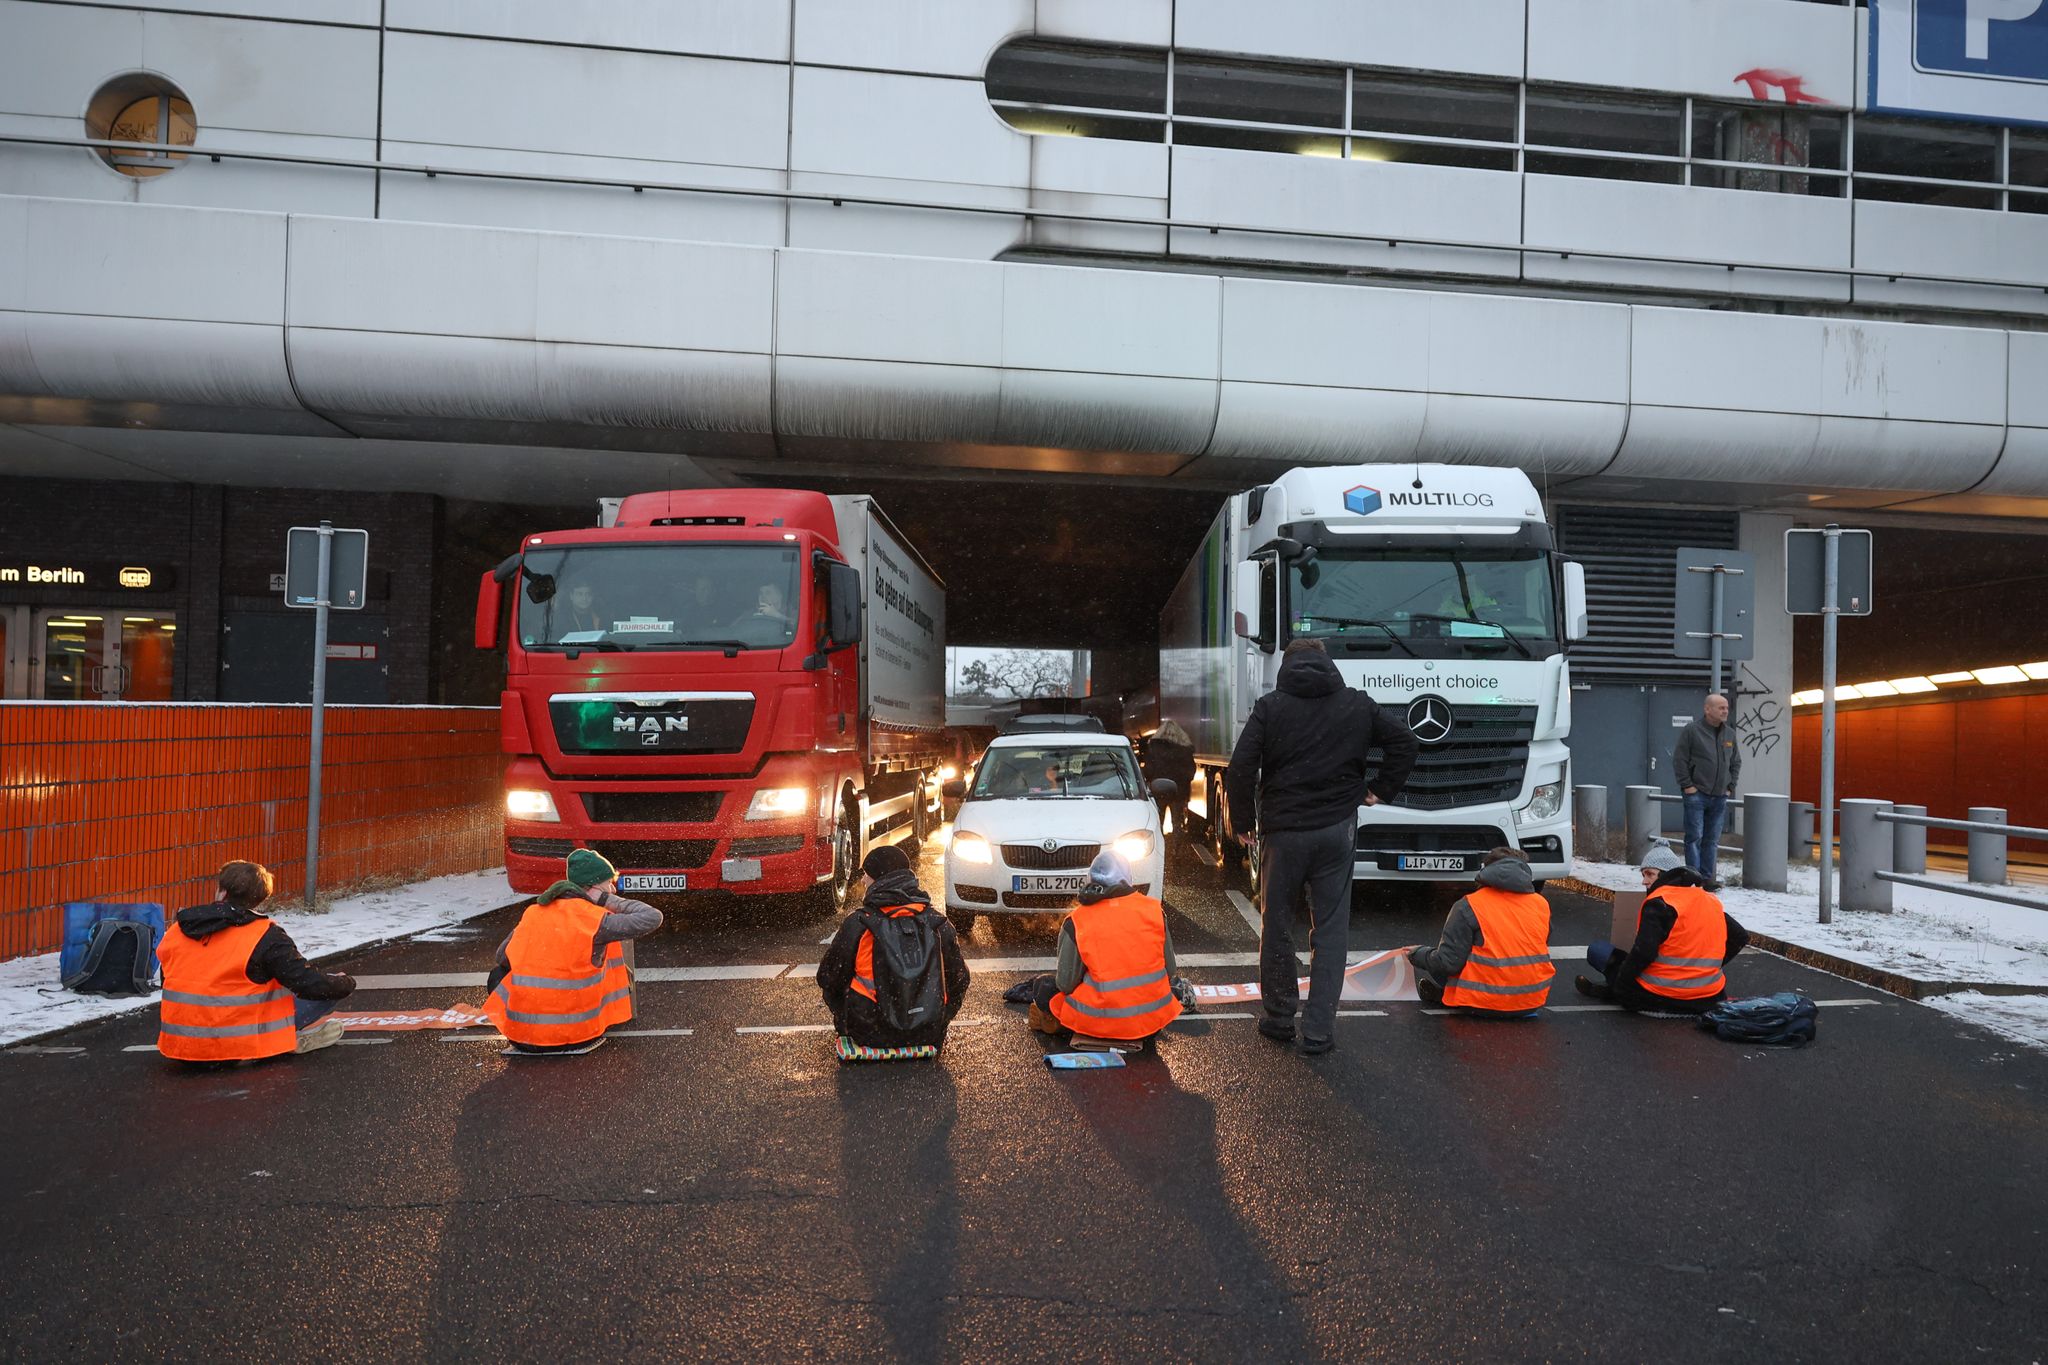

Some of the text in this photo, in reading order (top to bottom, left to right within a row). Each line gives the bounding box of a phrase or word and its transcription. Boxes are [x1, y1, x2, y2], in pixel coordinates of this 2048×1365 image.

[1389, 492, 1494, 507] MULTILOG
[27, 565, 85, 584] Berlin
[875, 565, 885, 600] Gas
[885, 579, 898, 612] geben
[620, 623, 667, 631] FAHRSCHULE
[1362, 673, 1499, 692] Intelligent choice
[612, 715, 689, 733] MAN
[1405, 857, 1463, 869] LIP VT 26
[624, 876, 685, 889] B EV 1000
[1021, 877, 1029, 890] B
[1036, 877, 1053, 890] RL
